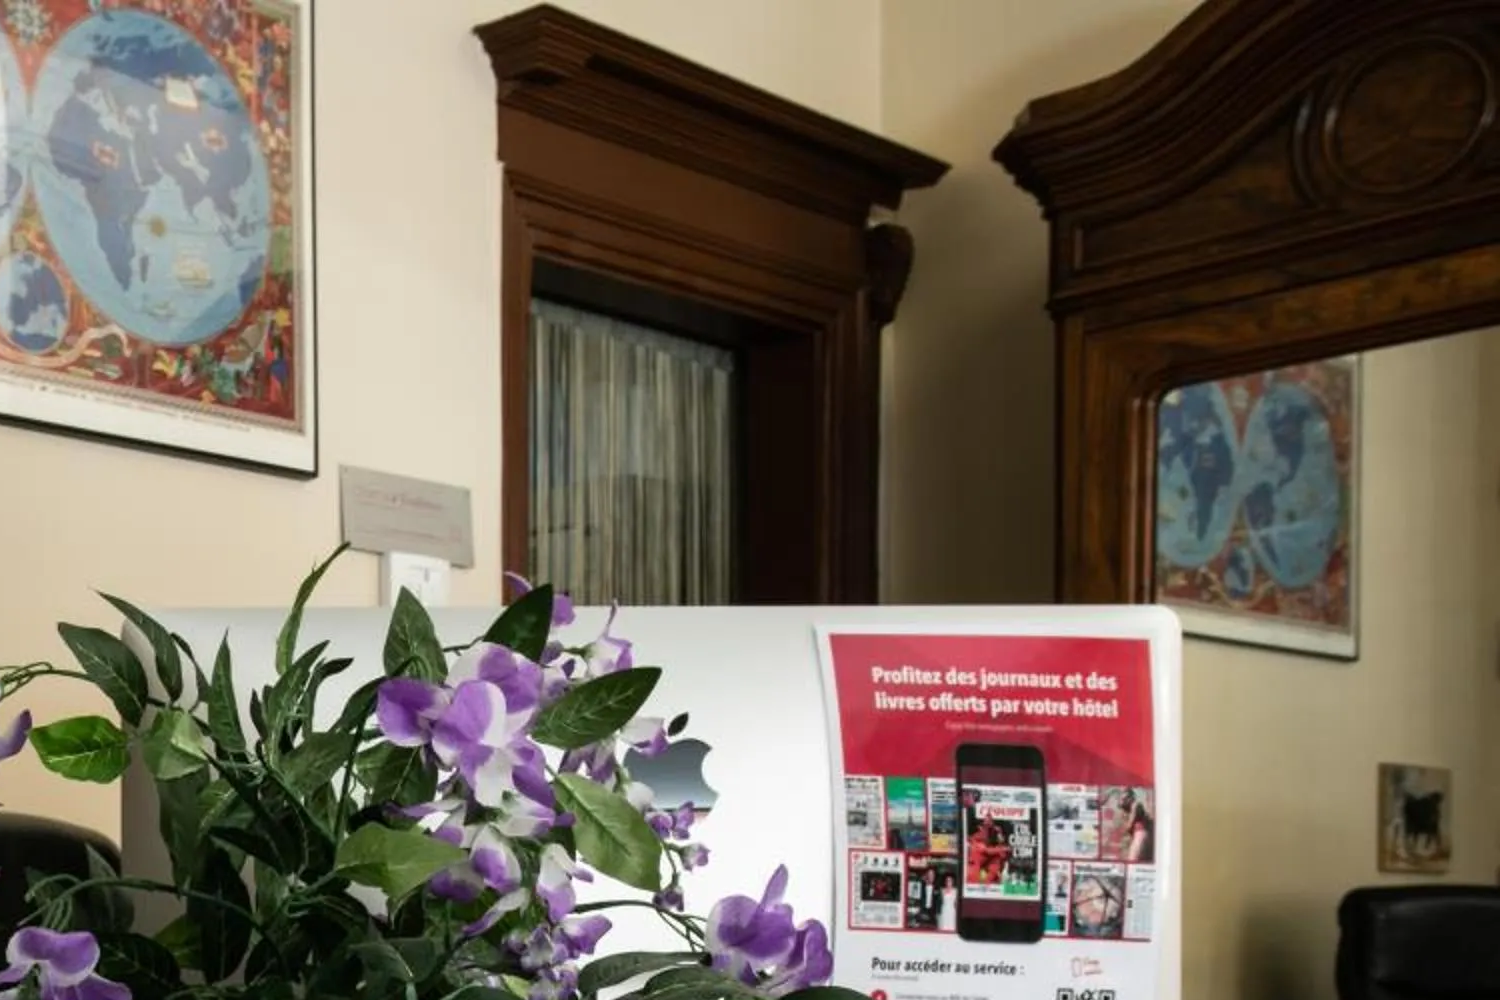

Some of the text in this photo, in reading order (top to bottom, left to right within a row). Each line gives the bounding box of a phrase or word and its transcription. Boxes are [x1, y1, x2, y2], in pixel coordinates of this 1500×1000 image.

[871, 666, 1118, 691] Profitez des journaux et des
[874, 691, 1119, 719] livres offerts par votre hôtel
[871, 956, 1018, 976] Pour accéder au service
